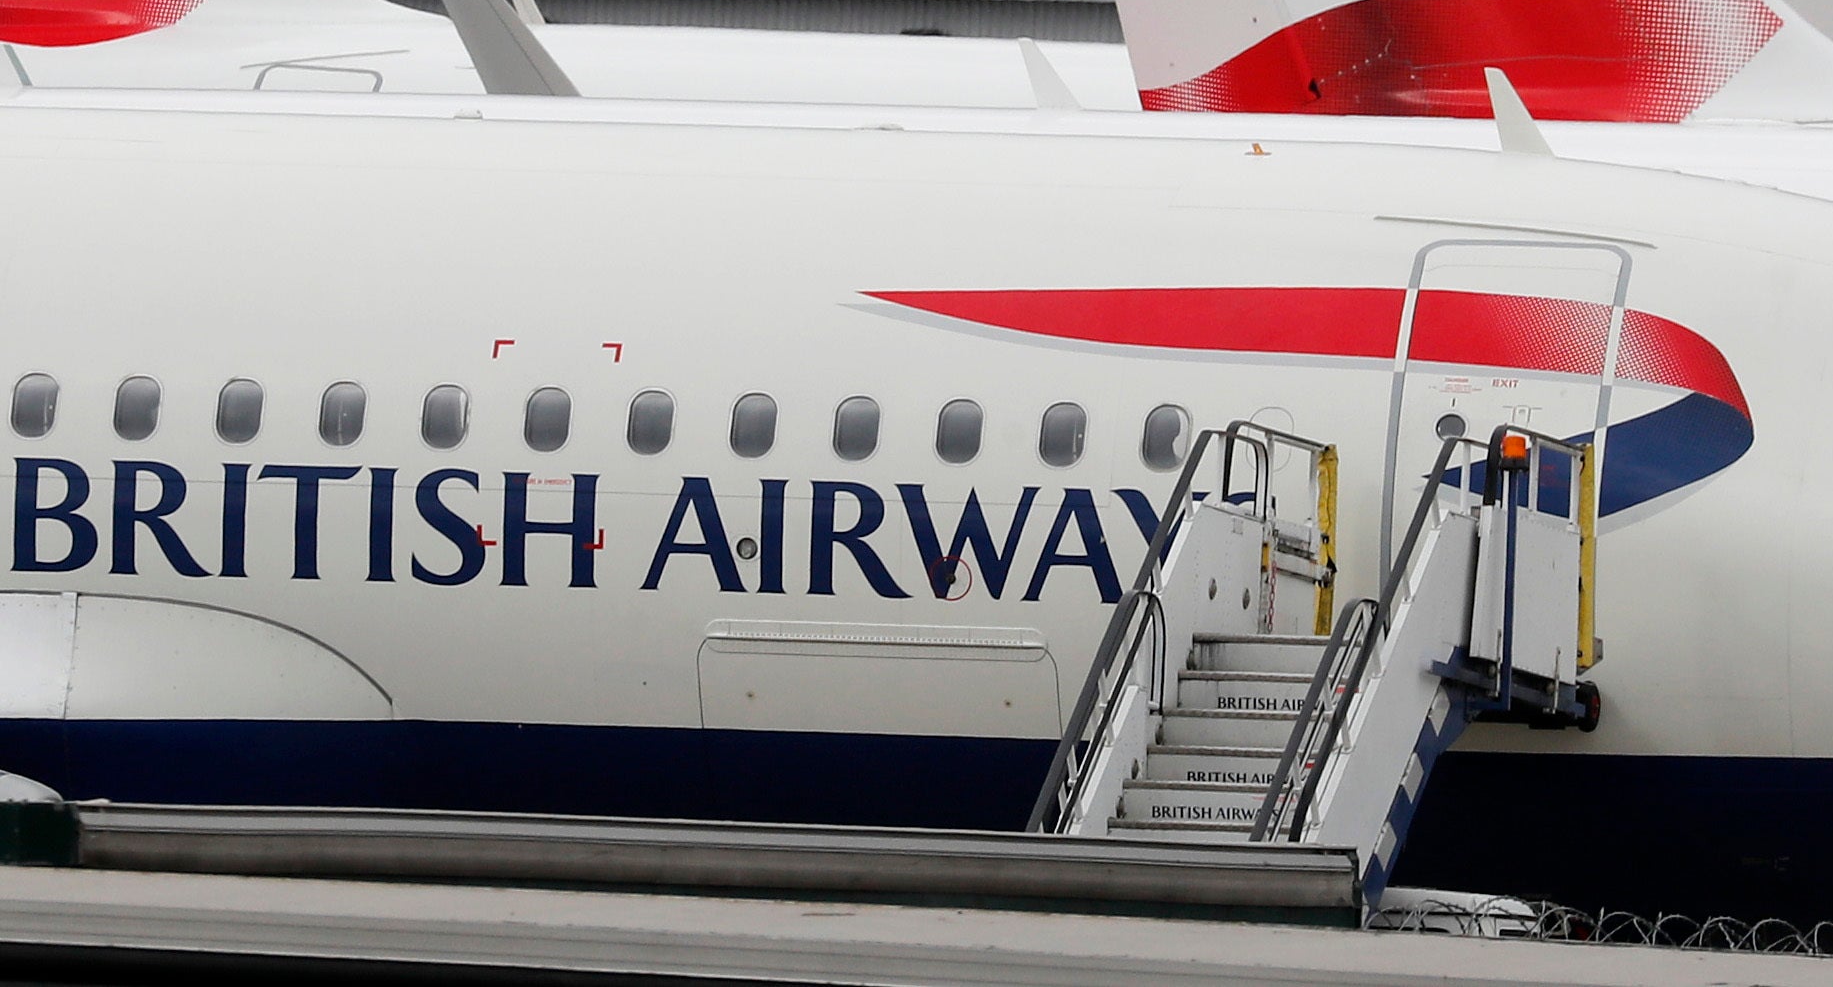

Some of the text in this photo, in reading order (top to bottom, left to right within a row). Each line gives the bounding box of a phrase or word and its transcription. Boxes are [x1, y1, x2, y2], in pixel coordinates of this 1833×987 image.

[1492, 378, 1519, 389] EXIT
[12, 456, 1257, 604] BRITISH AIRWAY
[1217, 696, 1278, 711] BRITISH
[1186, 771, 1248, 784] BRITISH
[1152, 805, 1212, 820] BRITISH
